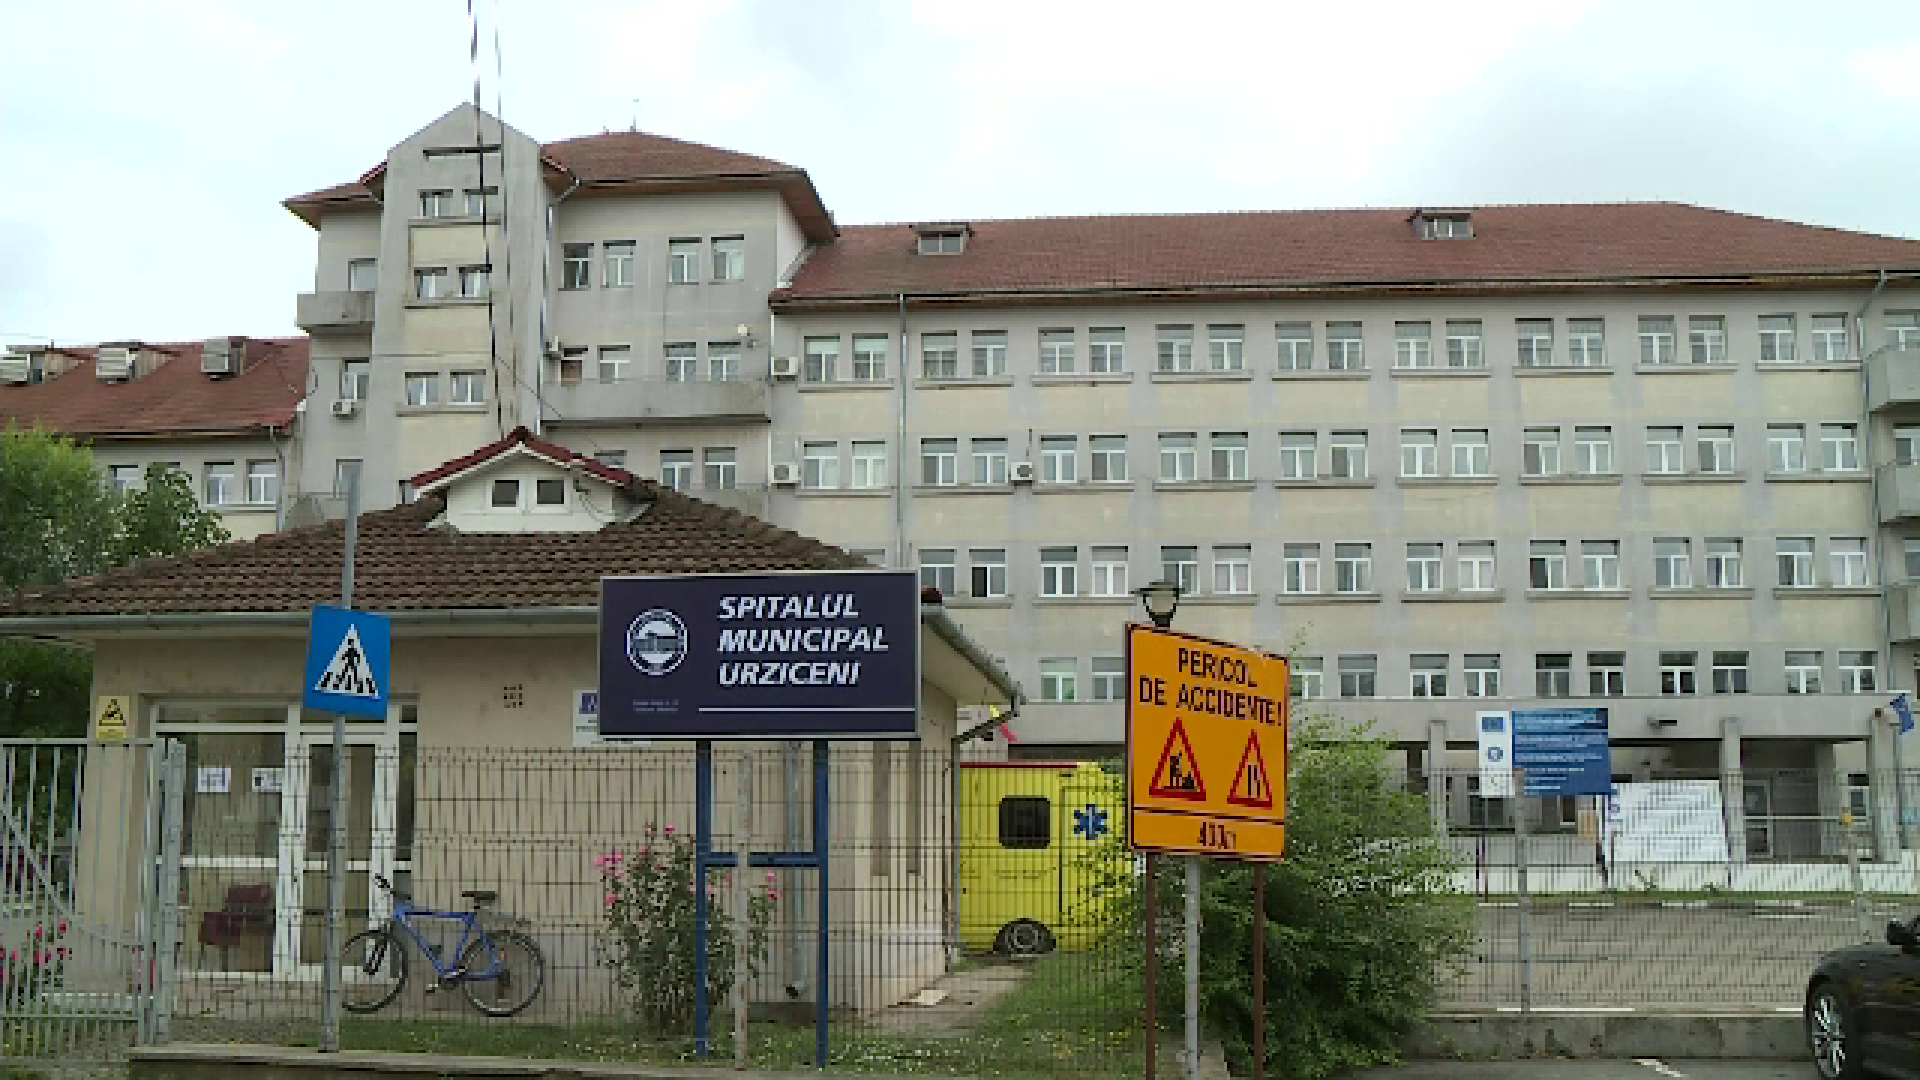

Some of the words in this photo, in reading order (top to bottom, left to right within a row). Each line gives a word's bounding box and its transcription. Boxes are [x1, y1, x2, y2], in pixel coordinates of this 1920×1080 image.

[718, 593, 859, 619] SPITALUL
[717, 627, 889, 652] MUNICIPAL
[718, 662, 862, 686] URZICENI
[1178, 647, 1258, 687] PERICOL
[1139, 676, 1167, 705] DE
[1176, 684, 1282, 727] ACCIDENTE!
